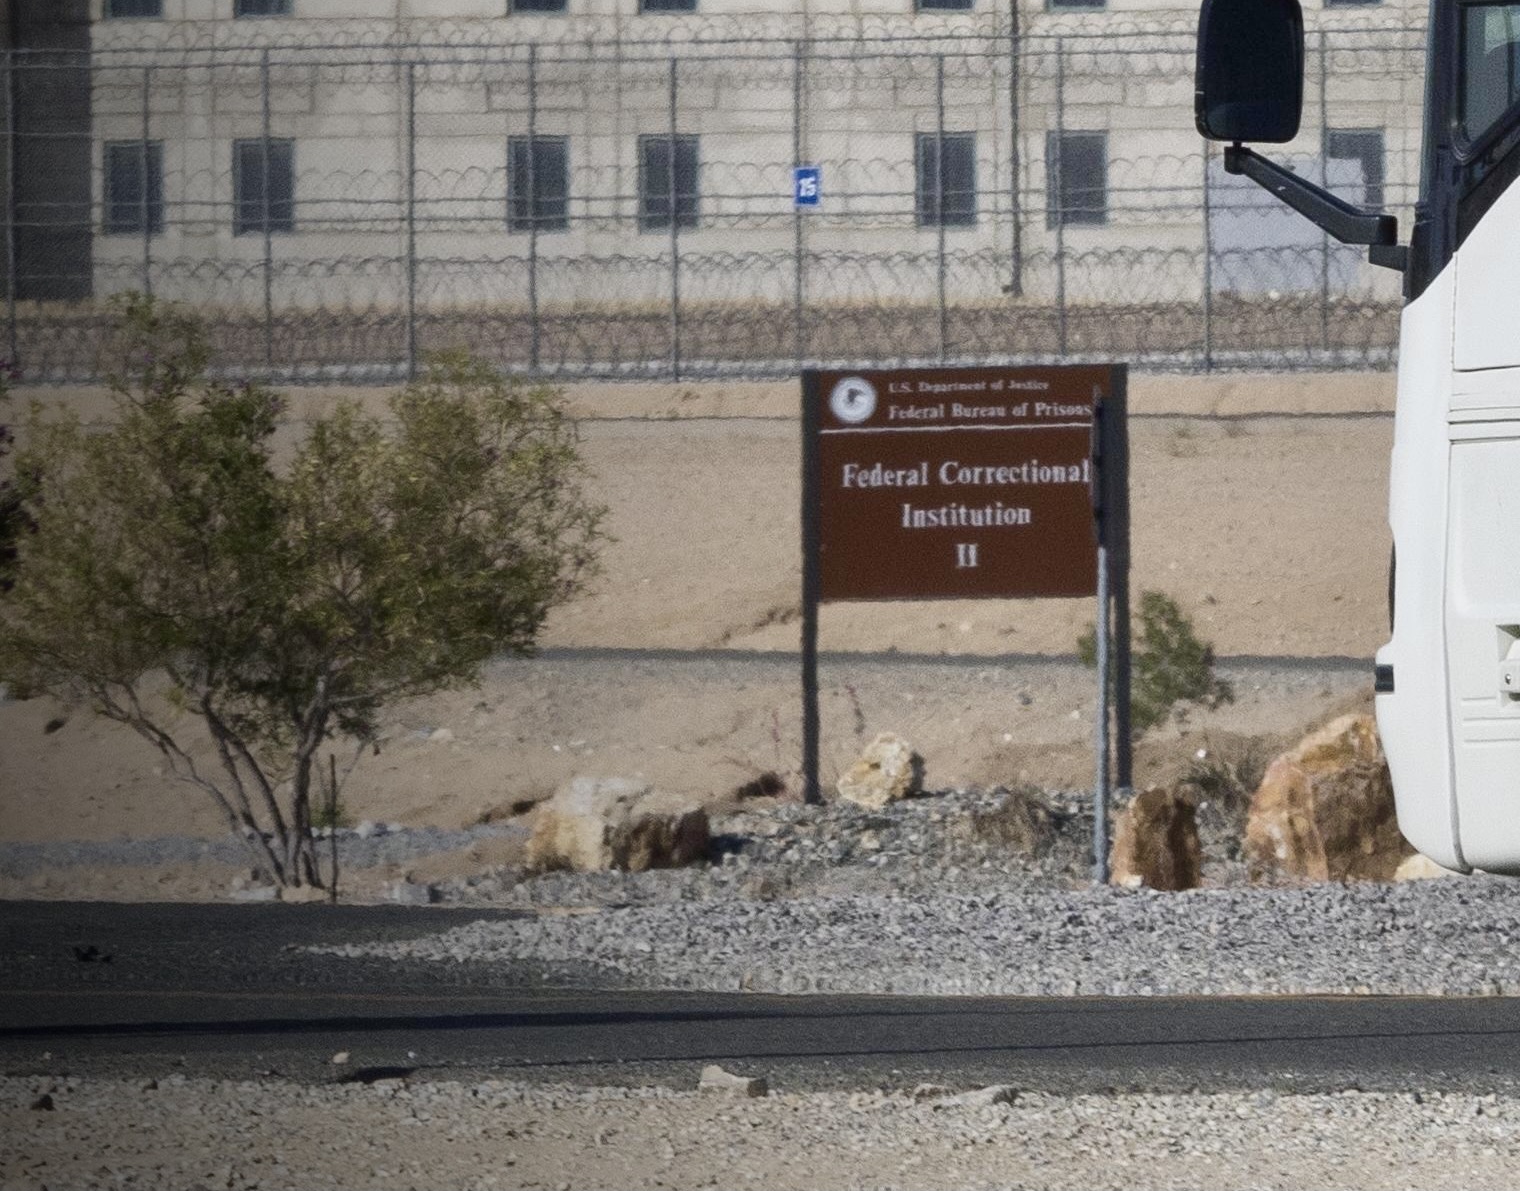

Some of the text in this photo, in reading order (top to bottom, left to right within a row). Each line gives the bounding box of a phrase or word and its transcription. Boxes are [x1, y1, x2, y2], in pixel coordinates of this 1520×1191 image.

[888, 379, 1049, 394] U.S. Department of Justice
[888, 401, 1093, 420] Federal Bureau of Prisons
[842, 459, 1091, 488] Federal Correctional
[902, 502, 1032, 528] Institution
[956, 544, 979, 568] II
